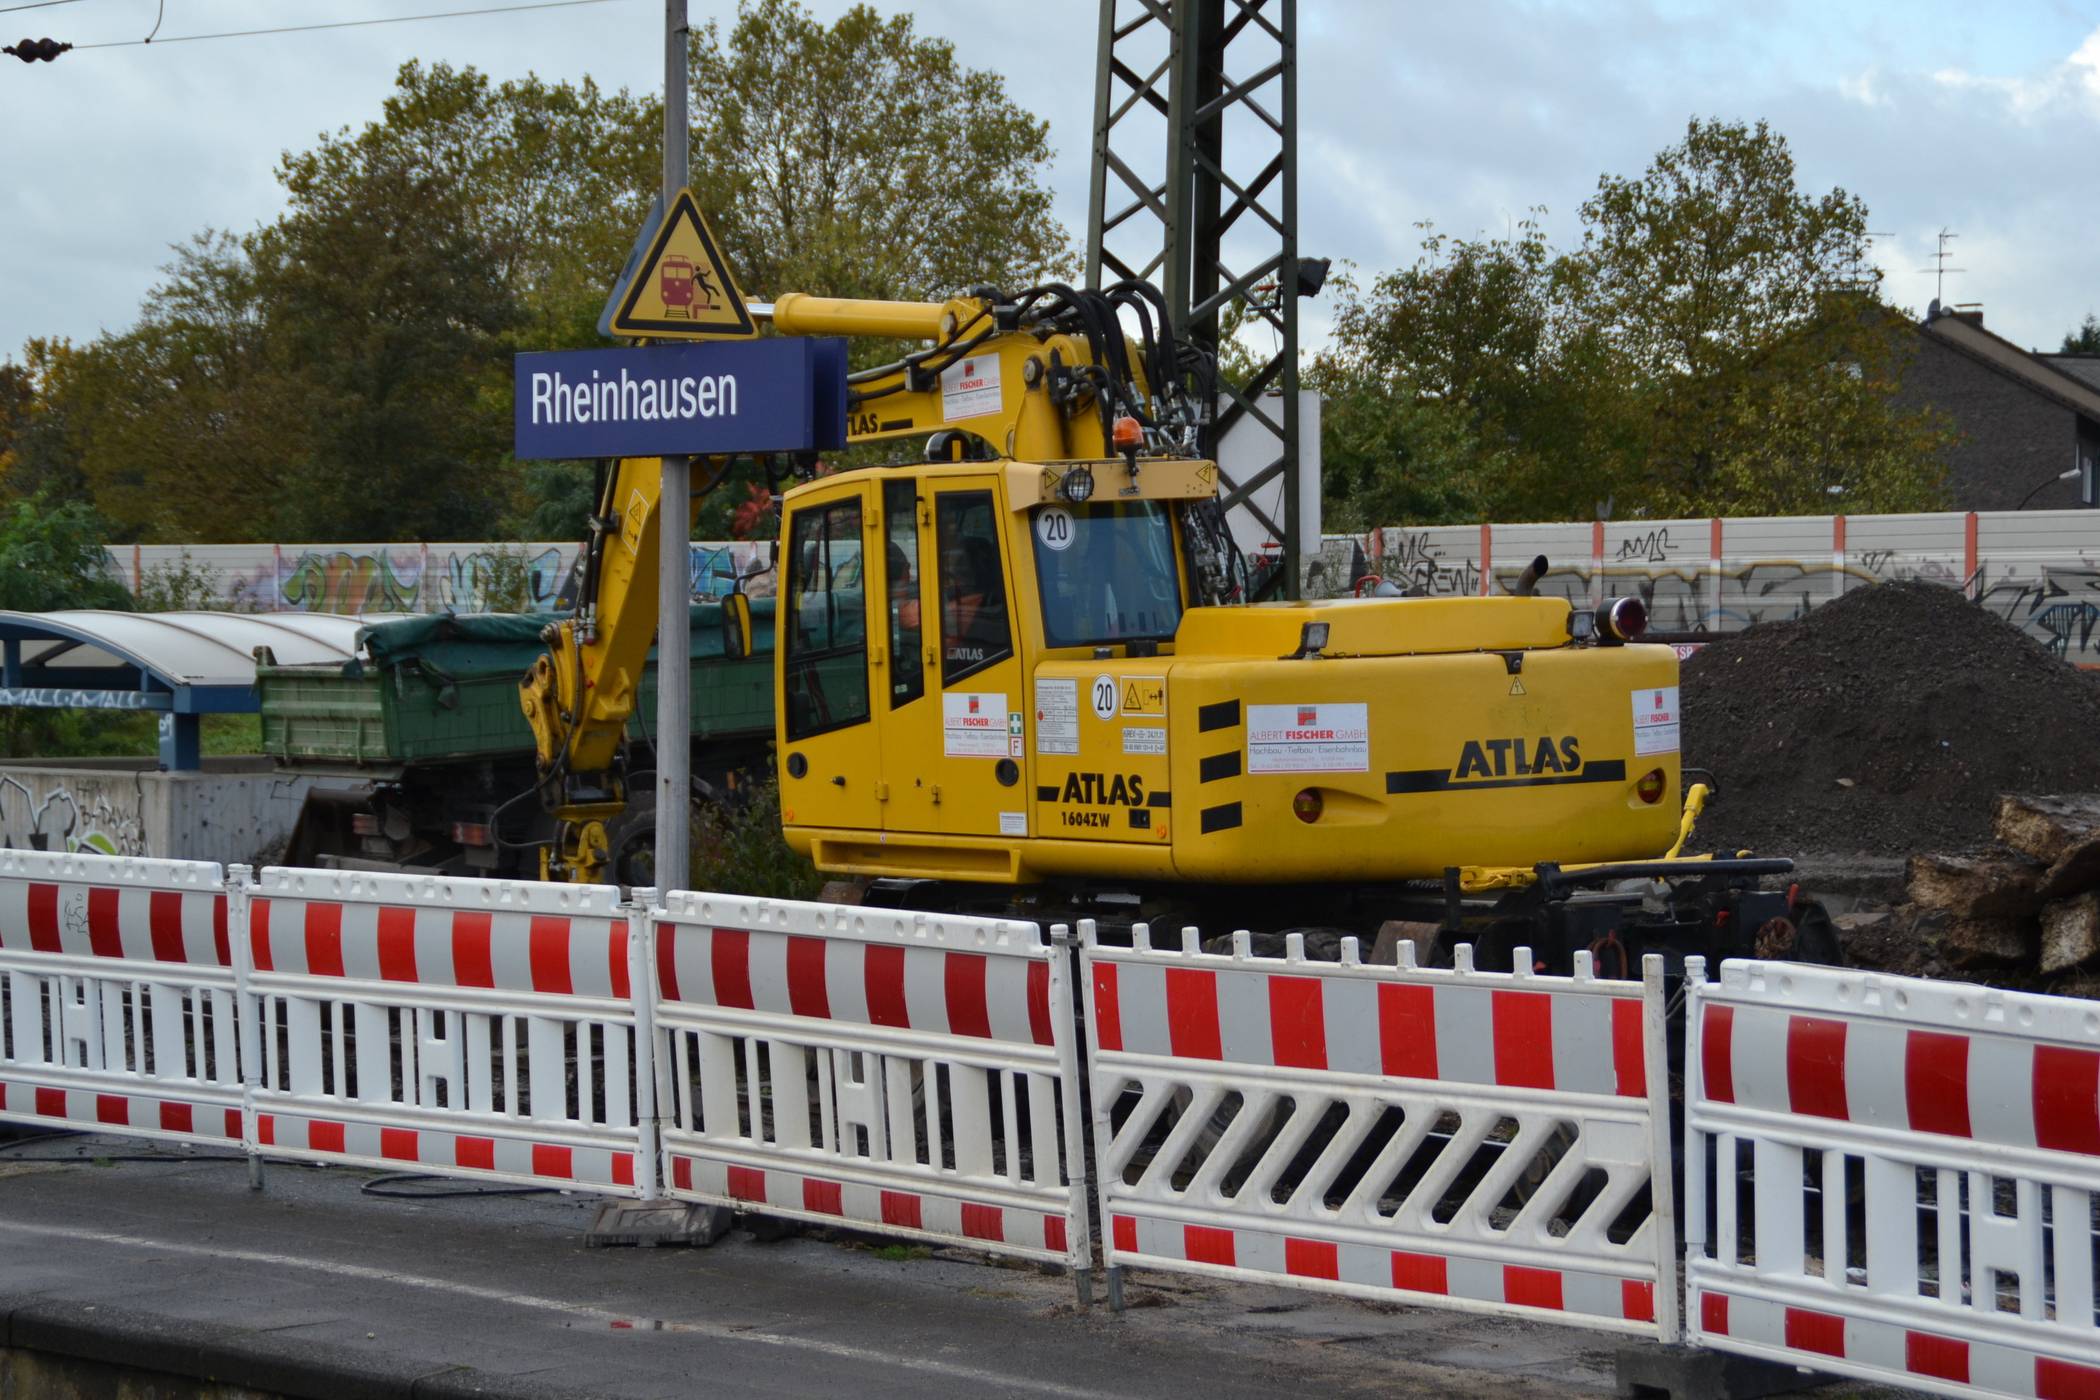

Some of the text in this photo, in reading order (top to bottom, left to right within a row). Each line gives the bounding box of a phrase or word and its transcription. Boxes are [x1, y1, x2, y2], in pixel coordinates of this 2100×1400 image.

[531, 367, 737, 425] Rheinhausen
[1044, 513, 1068, 541] 20
[955, 648, 984, 661] ATLAS
[1096, 683, 1113, 711] 20
[962, 717, 989, 727] FISCHER
[1249, 730, 1283, 741] ALBERT
[1285, 729, 1334, 740] FISCHER
[1013, 740, 1019, 755] F
[1249, 744, 1282, 755] Hochbau
[1455, 735, 1582, 779] ATLAS
[1061, 772, 1144, 807] ATLAS
[1061, 811, 1110, 828] 1604ZW
